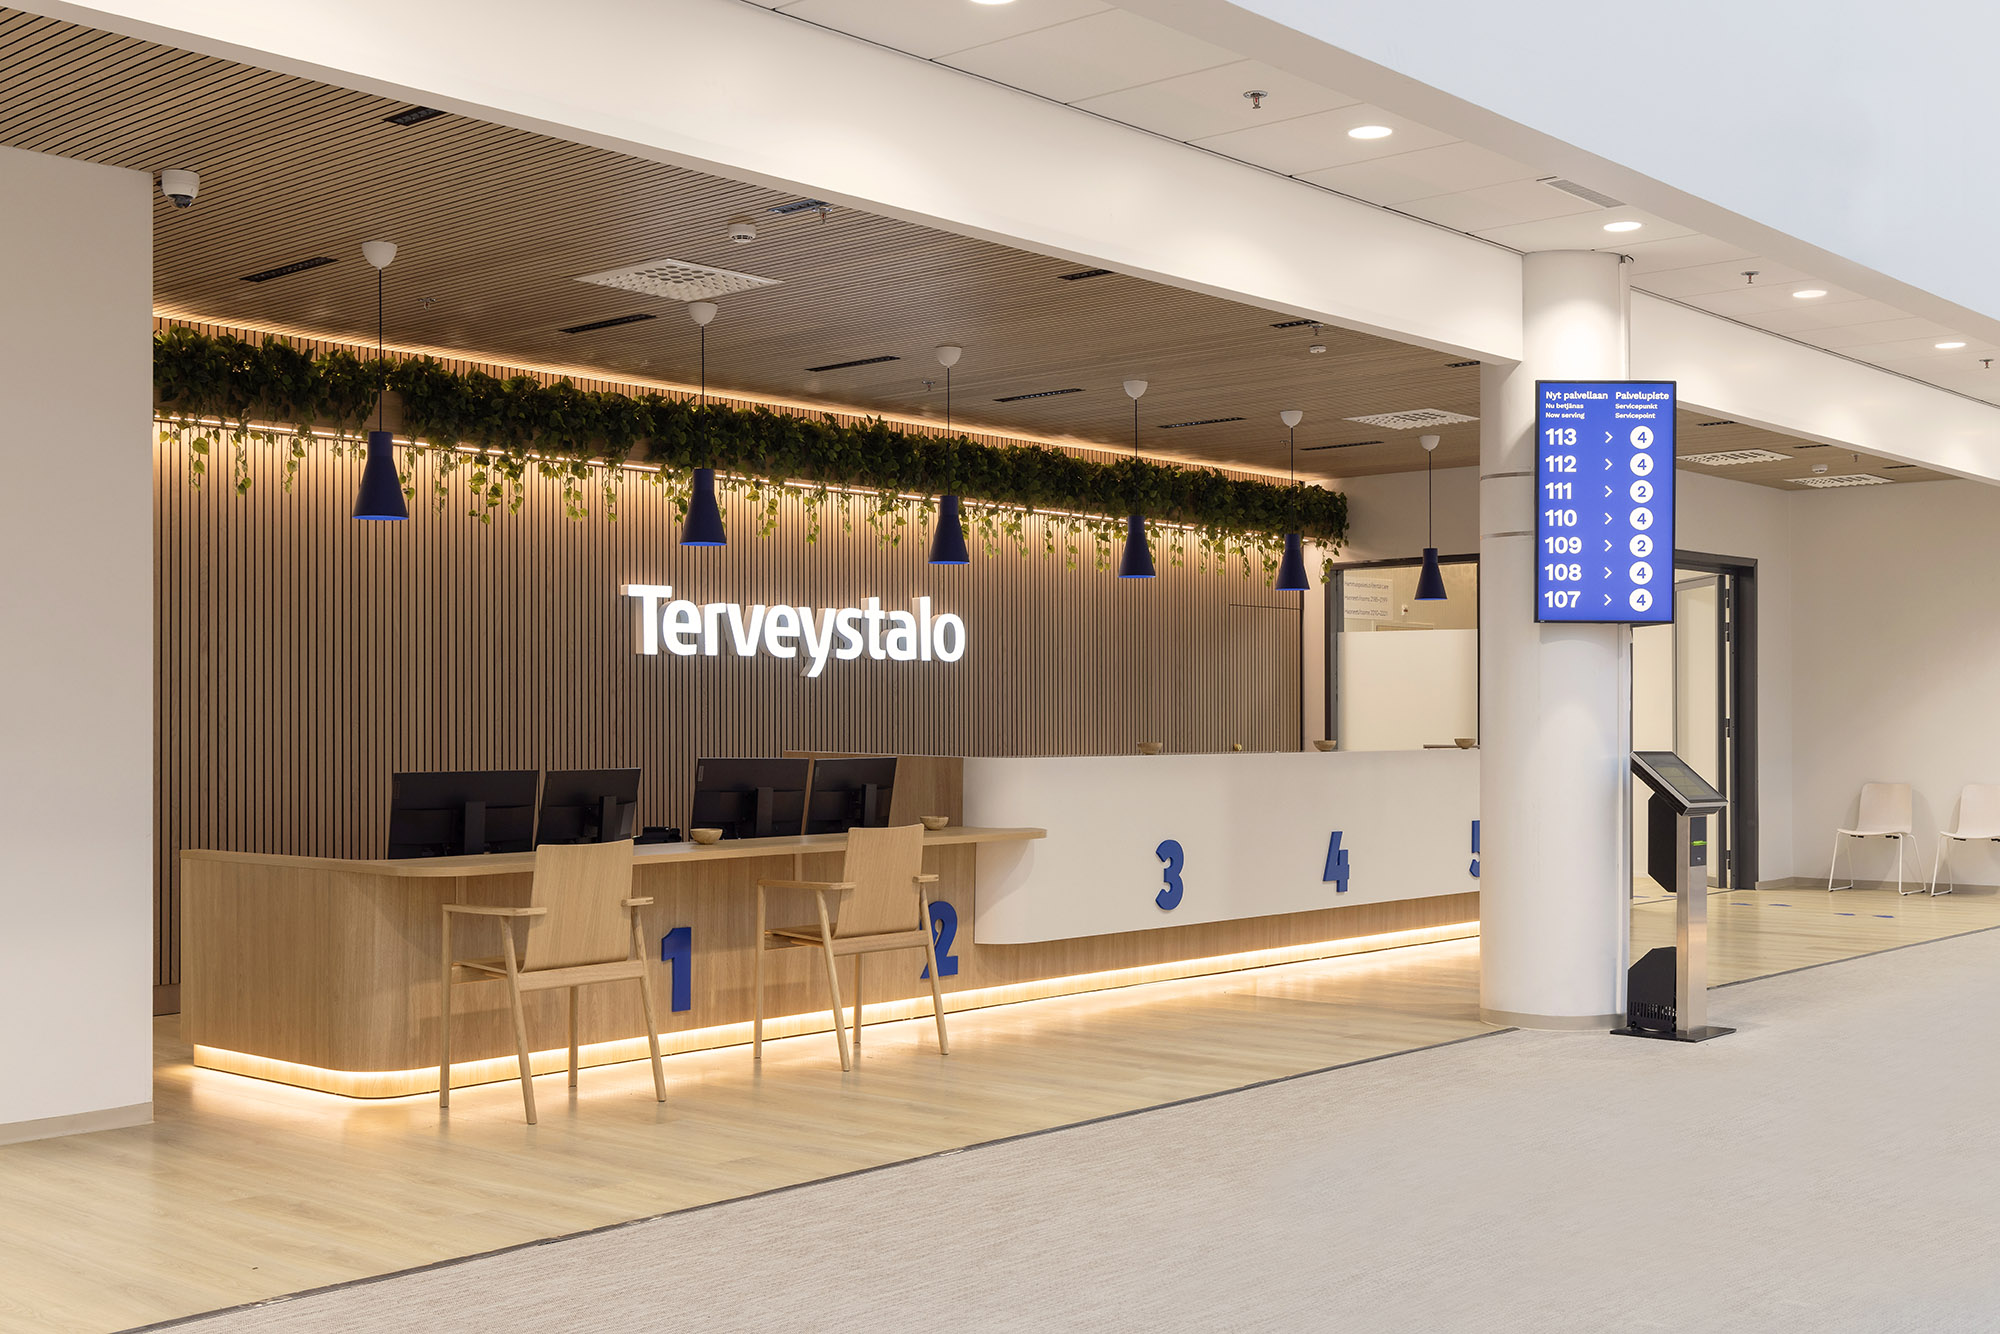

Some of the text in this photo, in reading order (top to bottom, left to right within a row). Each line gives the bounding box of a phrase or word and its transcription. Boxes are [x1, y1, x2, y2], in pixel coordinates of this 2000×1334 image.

[1545, 391, 1608, 401] Nyt palvellaan
[1615, 391, 1669, 401] Palvelupiste
[1556, 402, 1584, 410] betjänas
[1561, 412, 1585, 420] serving
[1615, 412, 1656, 420] Servicepoint
[1545, 428, 1647, 446] 113 4
[1545, 455, 1647, 473] 112 4
[1545, 482, 1646, 500] 111 2
[1545, 509, 1646, 527] 110 4
[1544, 536, 1646, 554] 109 2
[1544, 563, 1646, 581] 108 4
[1544, 590, 1646, 608] 107 4
[621, 584, 966, 678] Terveystalo
[1323, 830, 1350, 893] 4
[1155, 839, 1185, 911] 3
[920, 900, 959, 980] 2
[661, 926, 692, 1013] 1
